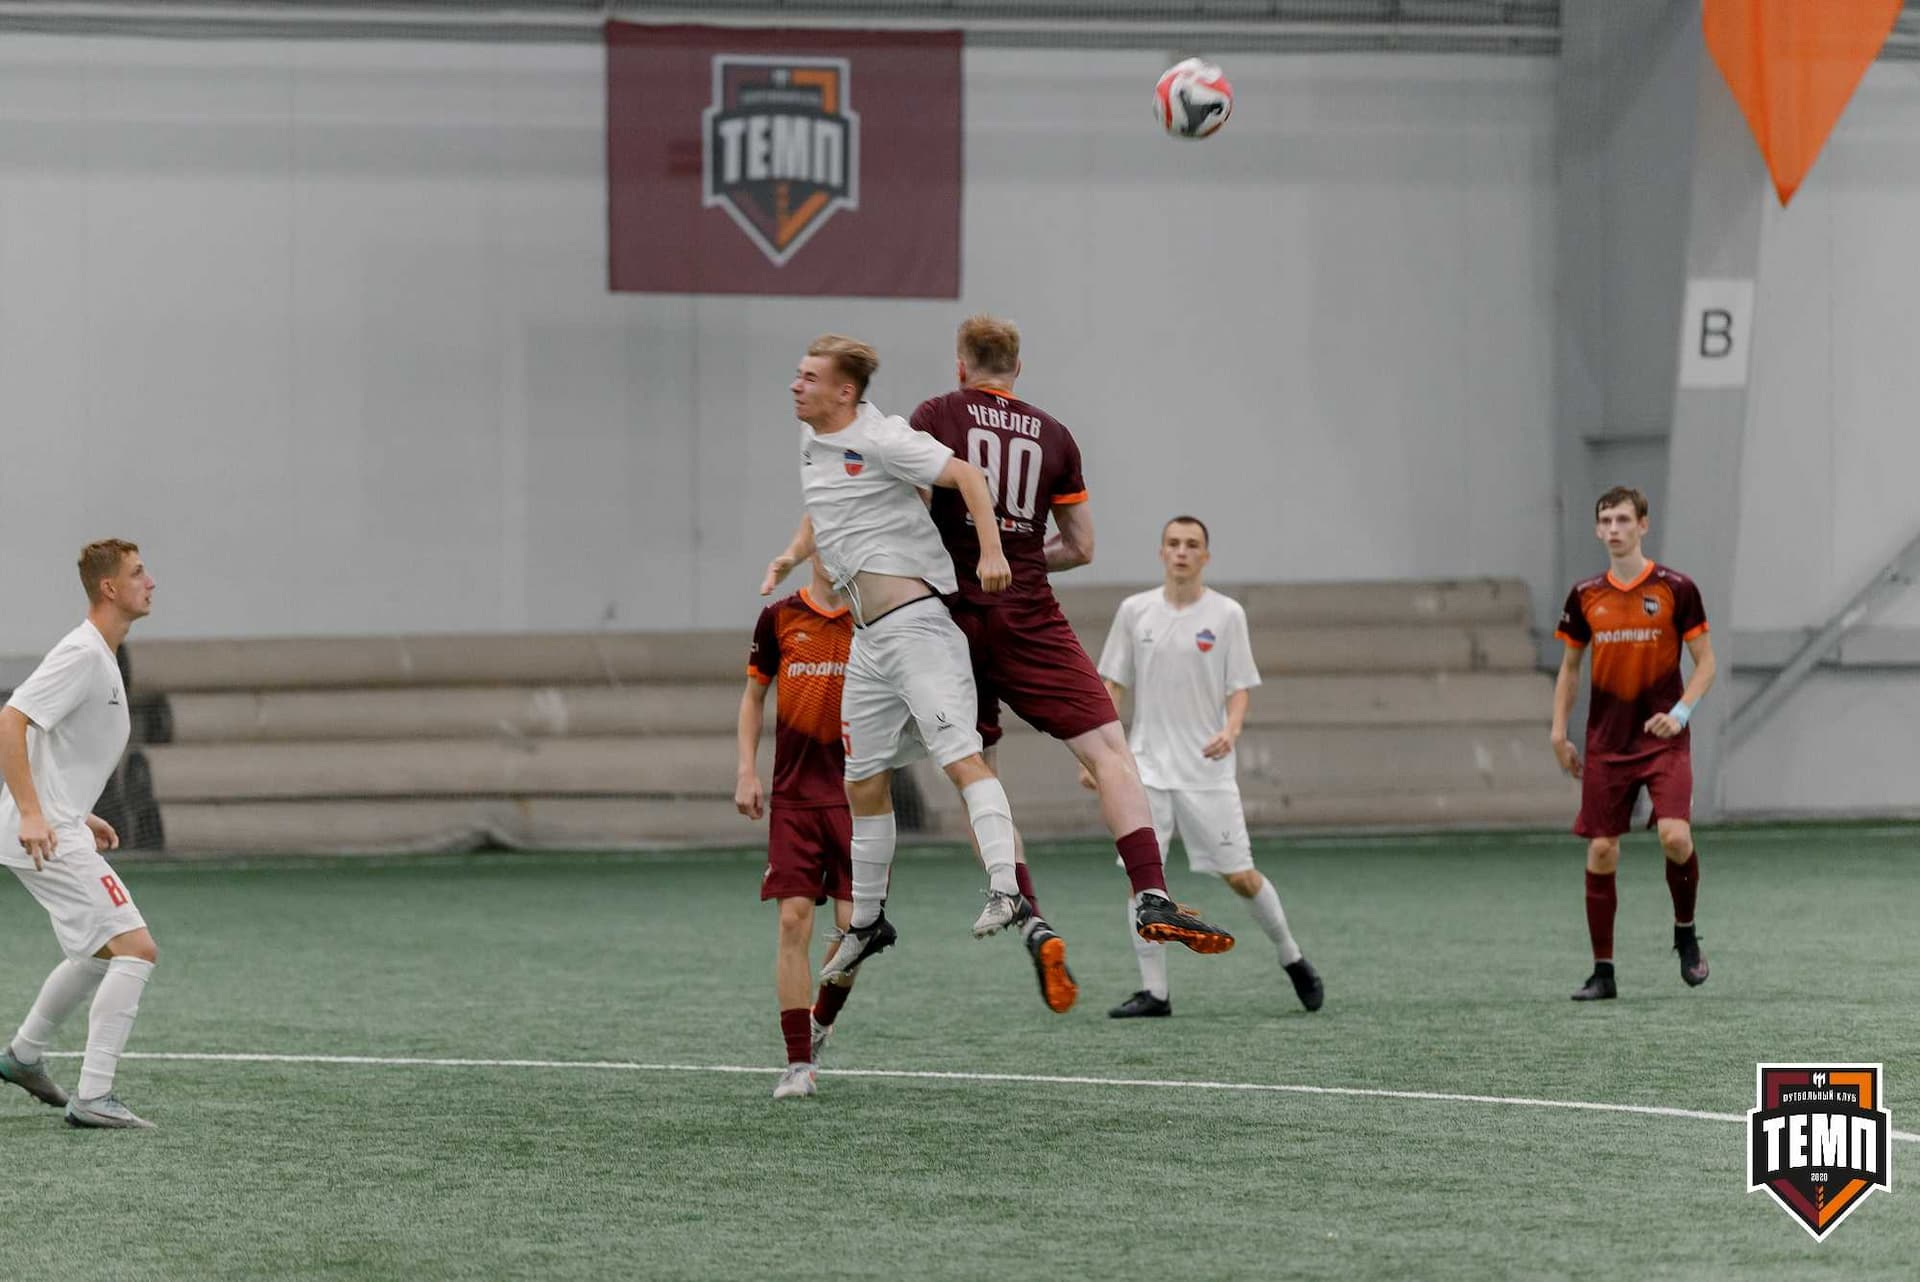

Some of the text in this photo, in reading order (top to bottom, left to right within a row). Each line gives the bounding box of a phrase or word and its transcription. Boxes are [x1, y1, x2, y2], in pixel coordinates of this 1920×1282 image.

[719, 114, 844, 187] ТЕМП
[967, 404, 1042, 438] ЧЕВЕЛЕВ
[100, 874, 128, 907] 8
